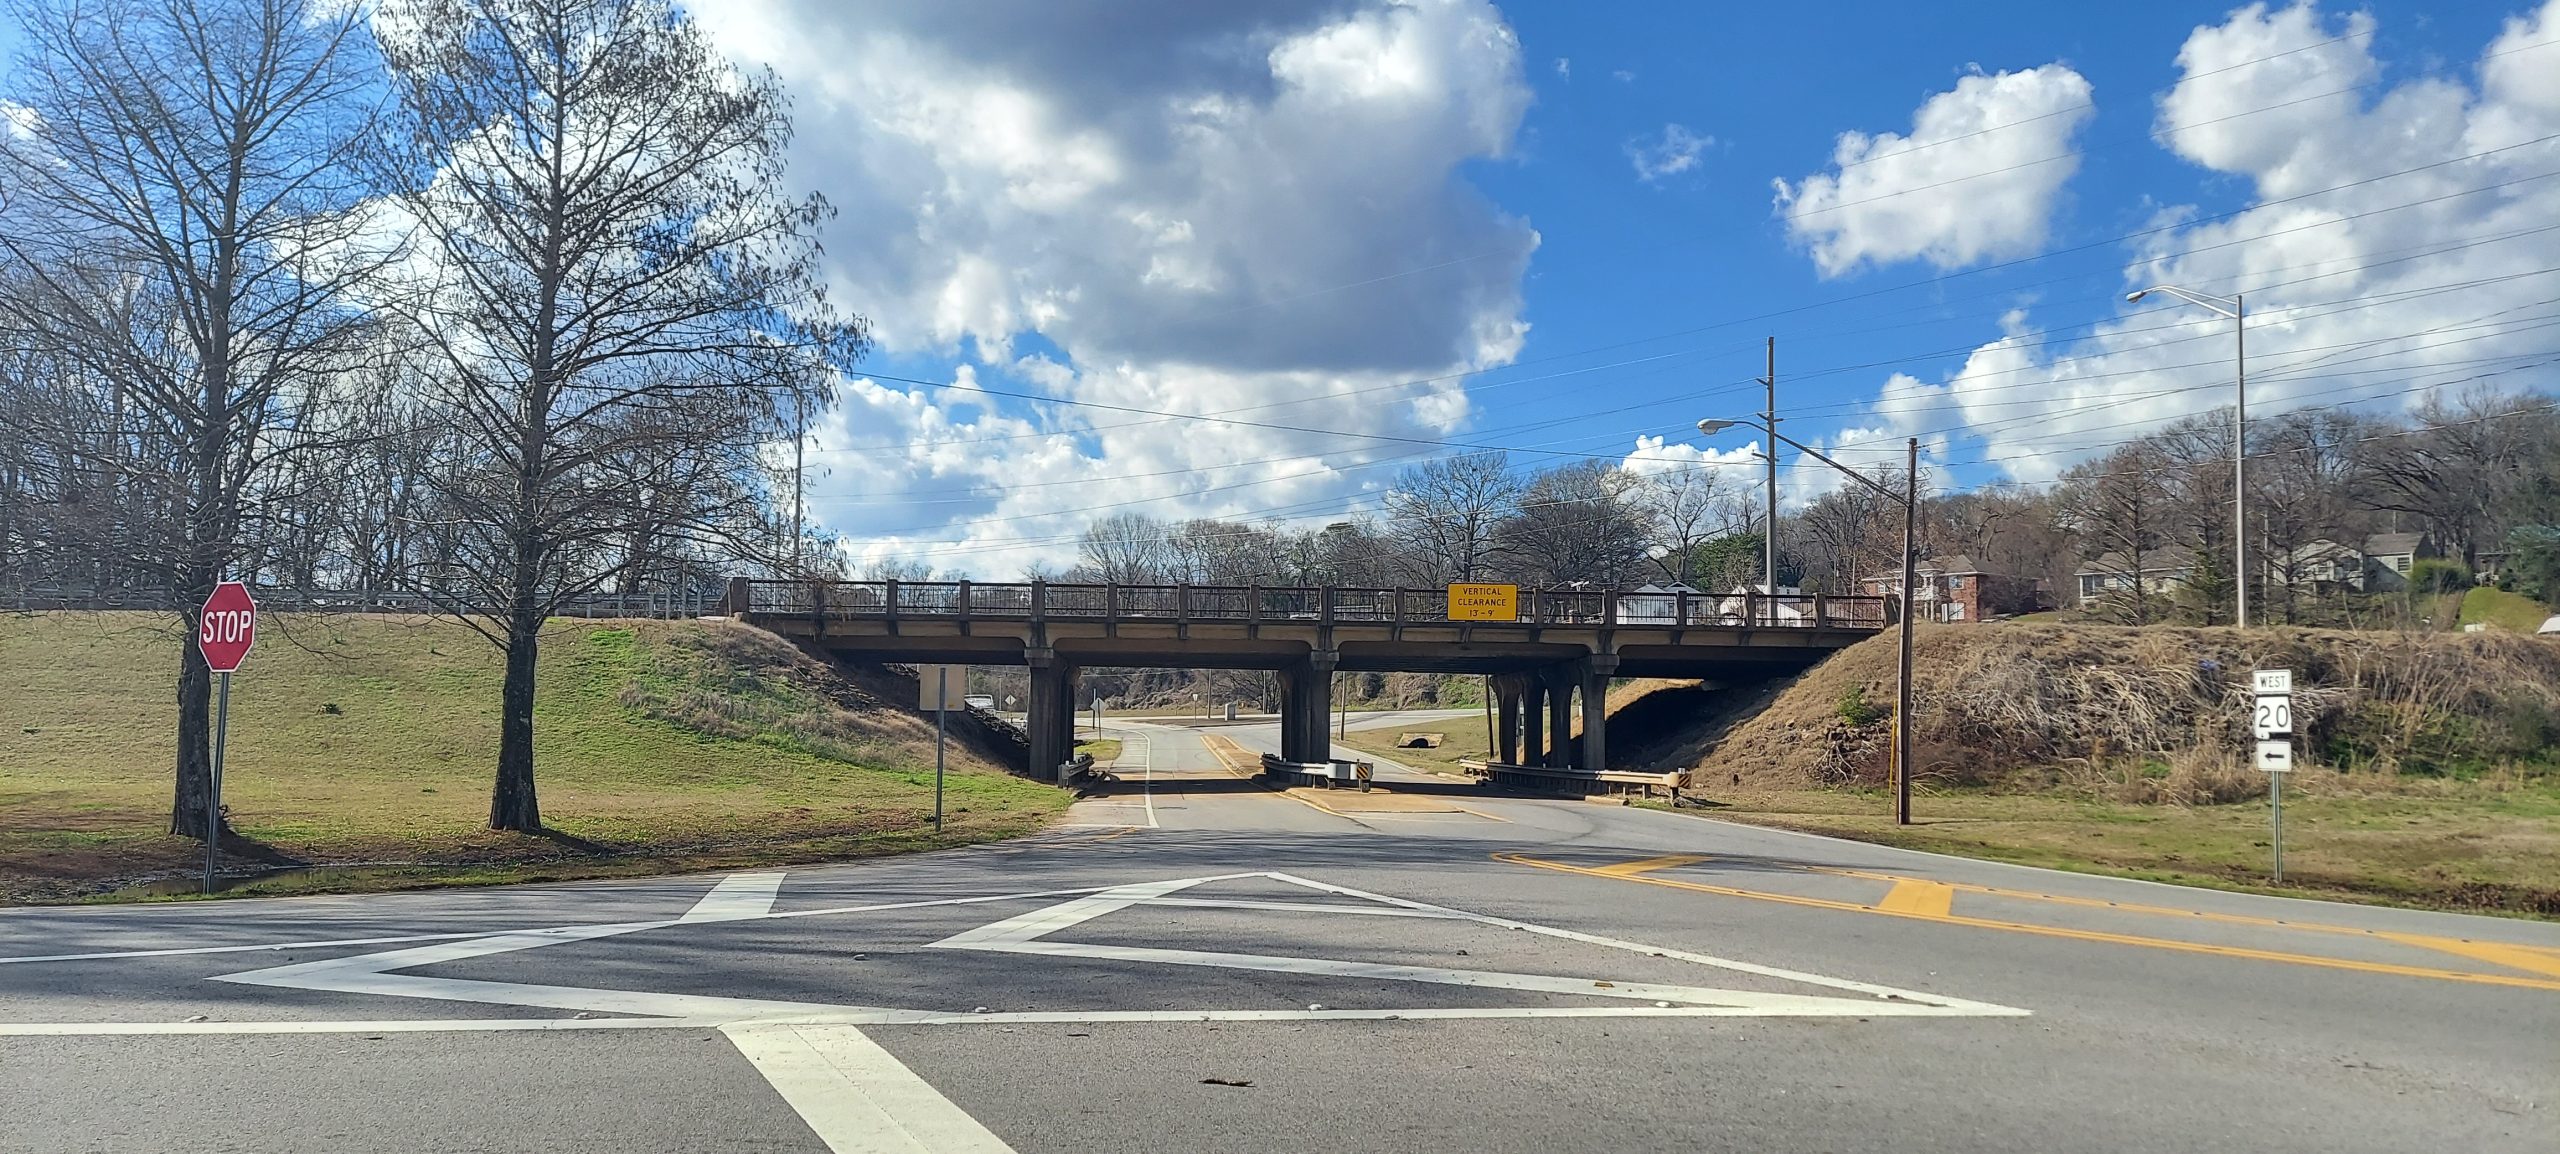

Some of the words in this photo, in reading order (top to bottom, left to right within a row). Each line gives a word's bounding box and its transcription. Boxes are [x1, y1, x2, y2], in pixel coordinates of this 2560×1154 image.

[203, 610, 252, 643] STOP
[2260, 676, 2286, 688] WEST
[2259, 704, 2288, 728] 20
